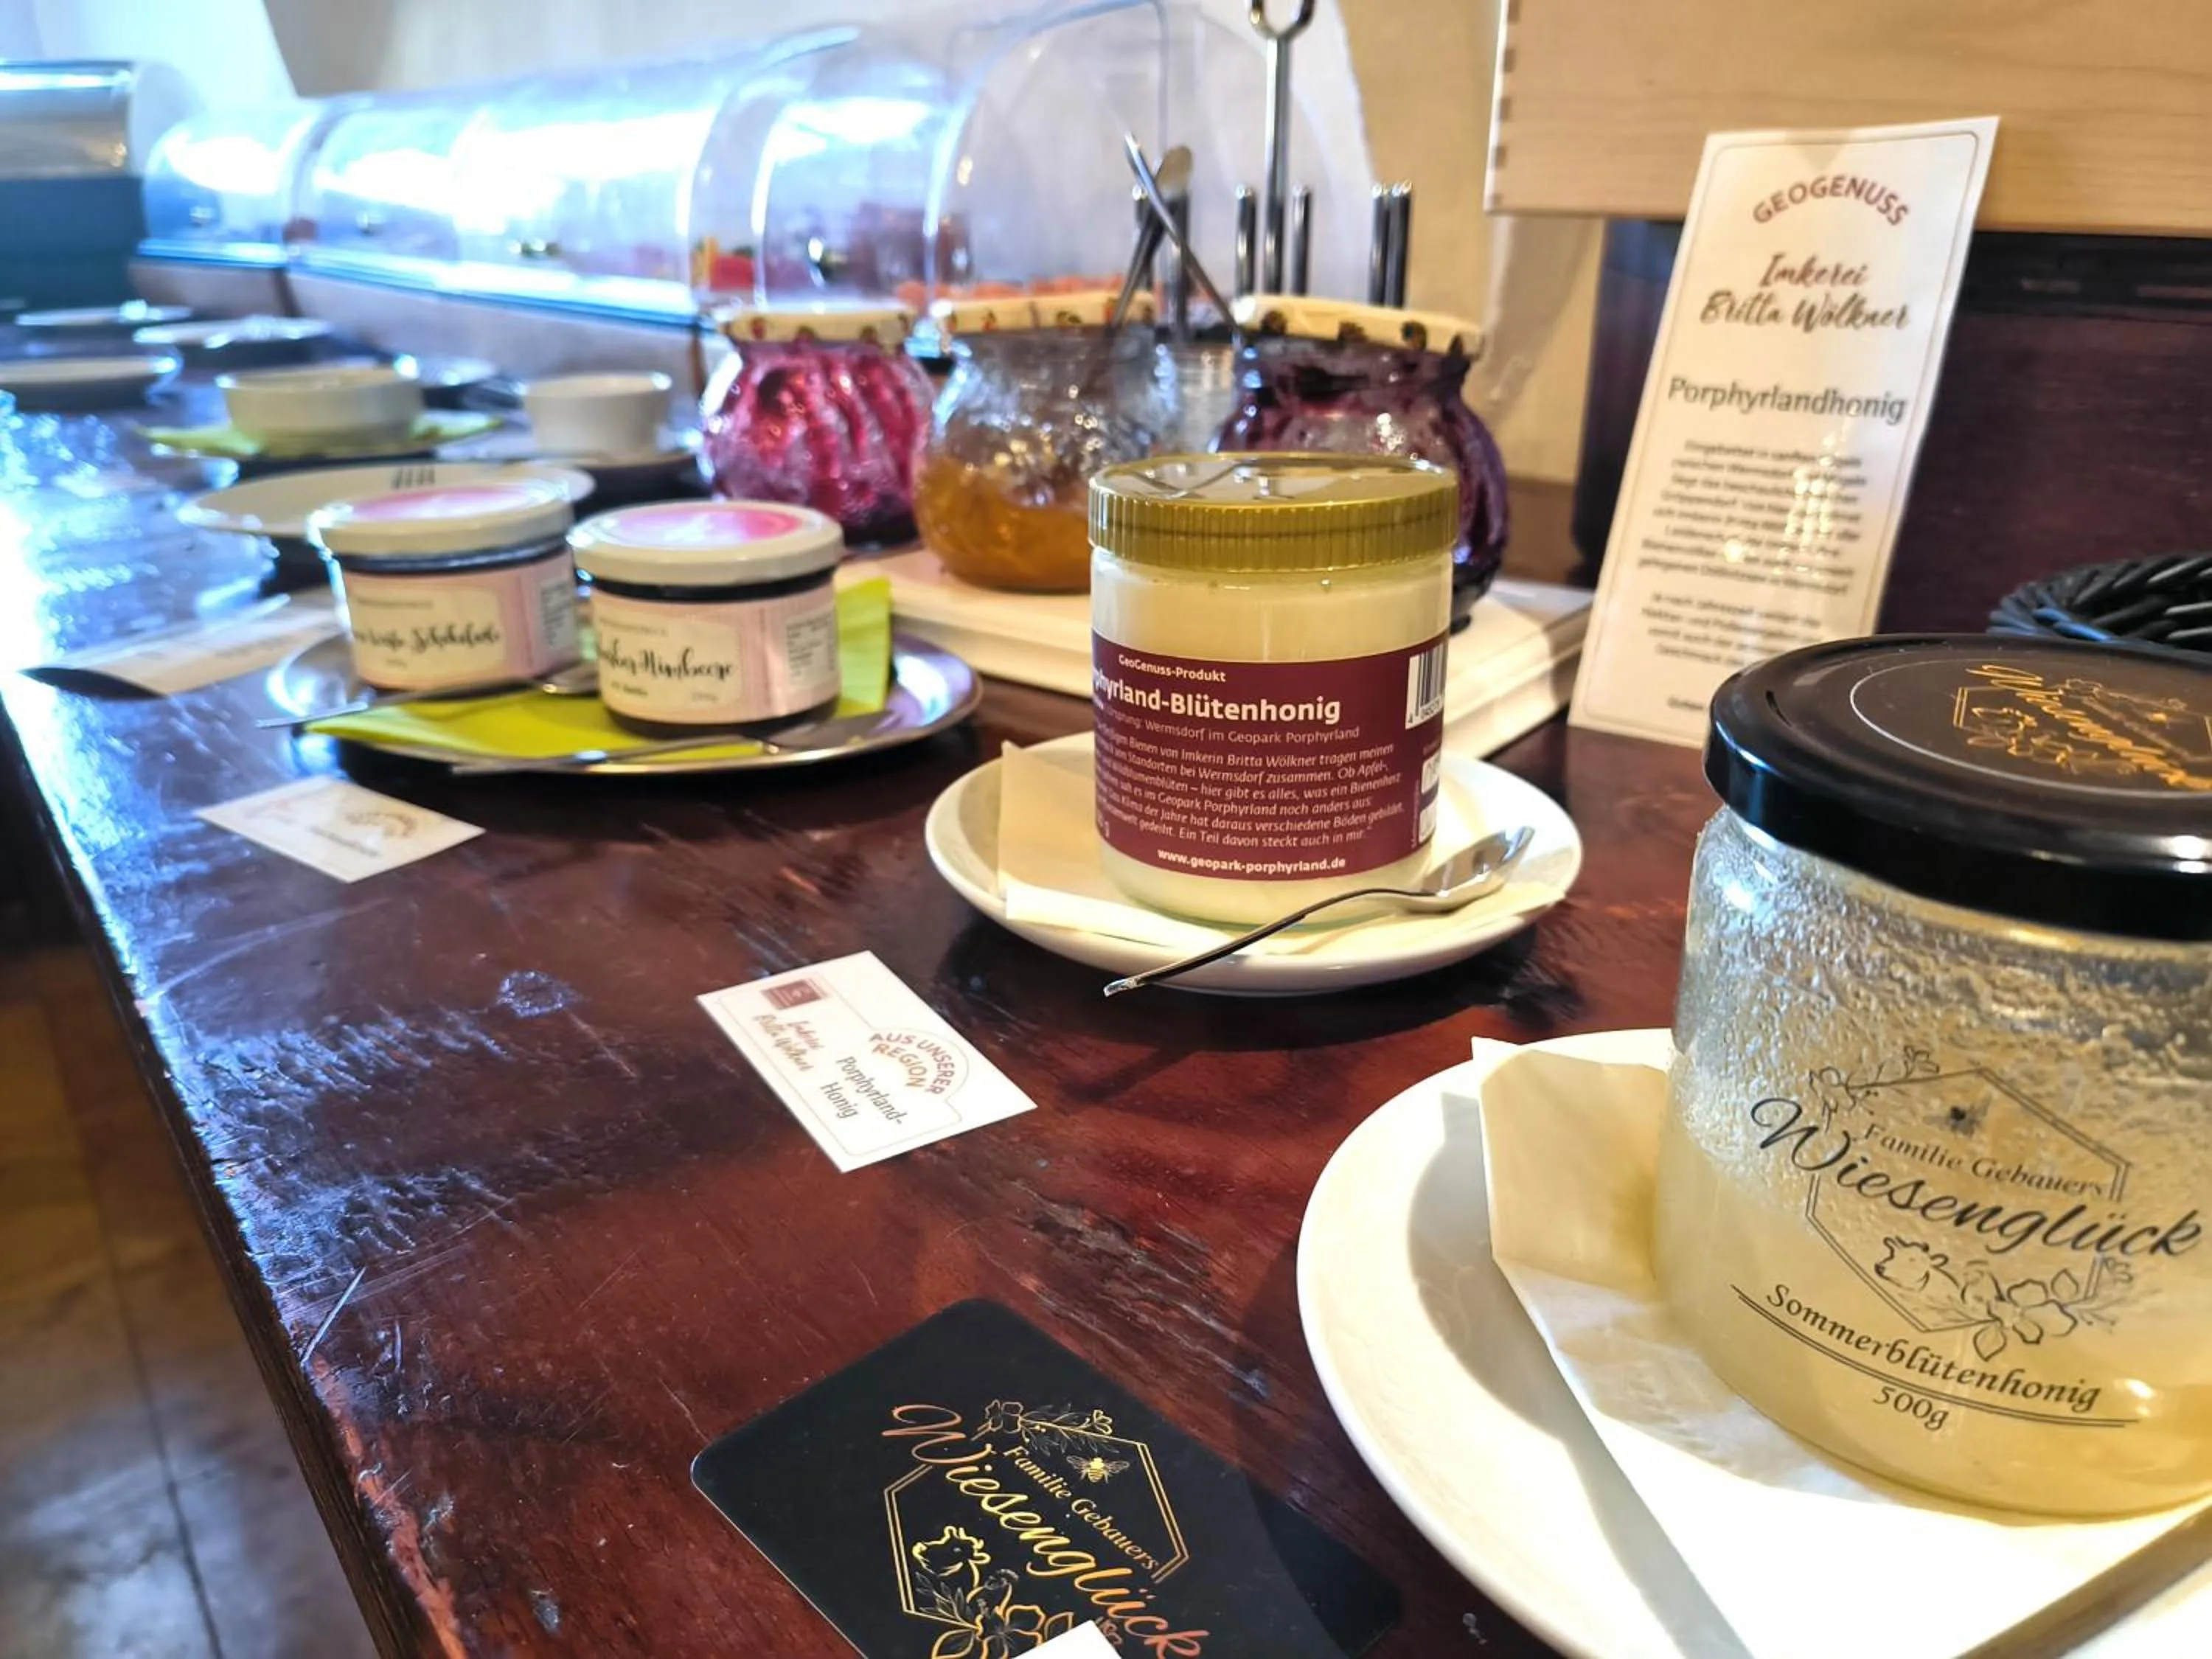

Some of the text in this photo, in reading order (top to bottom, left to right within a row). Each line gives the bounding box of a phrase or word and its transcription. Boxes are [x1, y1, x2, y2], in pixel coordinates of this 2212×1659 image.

[1753, 174, 1910, 226] GEOGENUSS
[1759, 251, 1869, 288] Imkerei
[1700, 290, 1910, 333] Britta Wölkner
[1668, 376, 1909, 425] Porphyrlandhonig
[1118, 654, 1227, 683] GeoGenuss-Produkt
[1145, 719, 1205, 742] Wermsdorf
[1208, 728, 1225, 742] im
[1228, 731, 1281, 745] Geopark
[1286, 726, 1360, 744] Porphyrland
[1127, 751, 1178, 775] Standorten
[1180, 765, 1195, 778] bei
[1198, 766, 1265, 786] Wermsdorf
[1266, 772, 1333, 785] zusammen.
[1338, 765, 1356, 779] Ob
[1161, 746, 1178, 759] von
[1182, 749, 1223, 766] Imkerin
[1228, 754, 1262, 768] Britta
[1266, 754, 1317, 768] Wölkner
[1320, 751, 1357, 767] tragen
[1158, 792, 1201, 810] Geopark
[1204, 799, 1276, 817] Porphyrland
[1279, 802, 1310, 815] noch
[1312, 800, 1350, 813] anders
[1352, 797, 1371, 810] aus
[1201, 782, 1222, 796] hier
[1225, 785, 1250, 800] gibt
[1253, 789, 1266, 799] es
[1304, 787, 1328, 799] was
[1331, 784, 1349, 796] ein
[1161, 809, 1188, 824] Jahre
[1190, 813, 1209, 827] hat
[1211, 816, 1252, 832] daraus
[1255, 817, 1330, 833] verschiedene
[1333, 812, 1366, 828] Böden
[1180, 827, 1196, 841] Ein
[1200, 830, 1220, 844] Teil
[1222, 834, 1259, 848] davon
[1262, 833, 1298, 847] steckt
[1301, 831, 1329, 846] auch
[1332, 830, 1344, 844] in
[1157, 849, 1346, 875] www.geopark-porphyrland.de
[869, 1032, 956, 1096] AUS UNSERER
[872, 1043, 928, 1089] REGION
[820, 1081, 859, 1119] Honig
[835, 1055, 908, 1125] Porphyrland-
[1750, 1097, 2202, 1258] Wiesenglück
[1860, 1122, 2104, 1197] Familie Gebauers
[1767, 1284, 2102, 1413] Sommerblütenhonig
[1873, 1385, 1950, 1432] 500g
[1003, 1444, 1160, 1572] Familie Gebauers
[882, 1404, 1210, 1659] Wiesenglück
